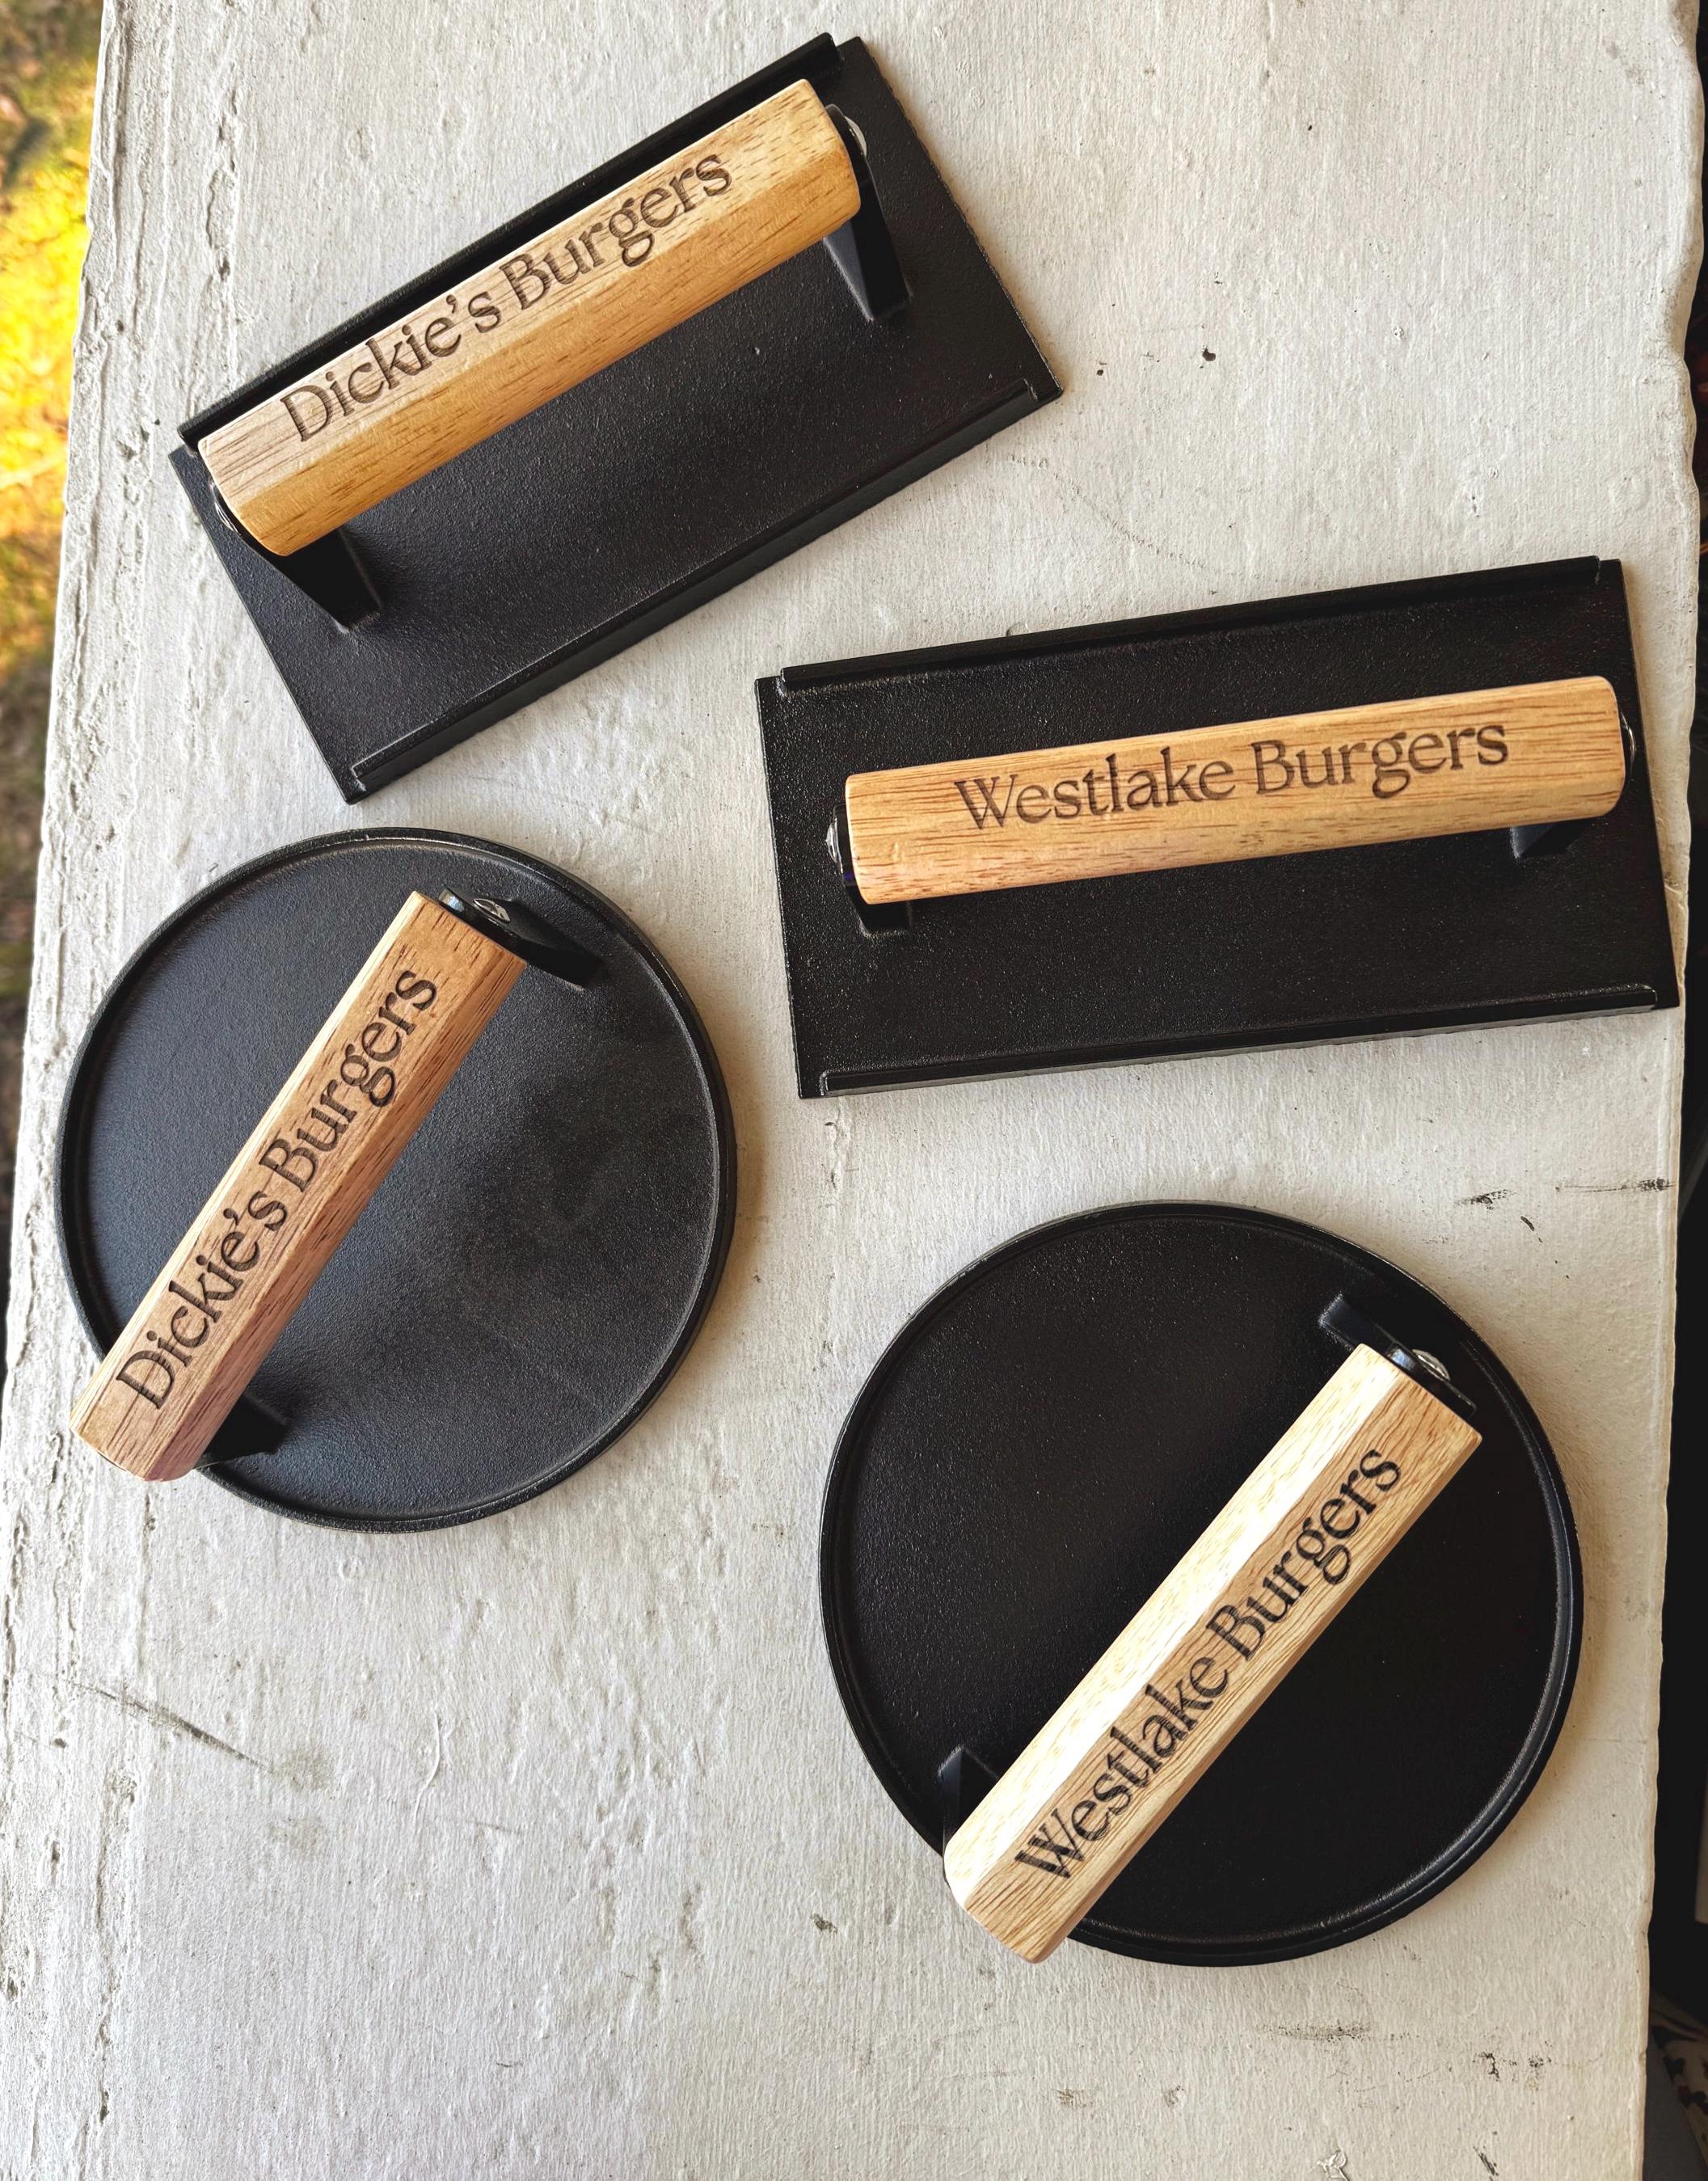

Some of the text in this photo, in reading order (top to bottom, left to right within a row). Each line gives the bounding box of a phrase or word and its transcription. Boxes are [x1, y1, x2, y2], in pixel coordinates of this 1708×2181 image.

[280, 152, 732, 442] Dickie's Burgers
[954, 723, 1509, 830] Westlake Burgers
[116, 969, 438, 1410] Dickie's Burgers
[1014, 1448, 1401, 1880] Westlake Burgers
